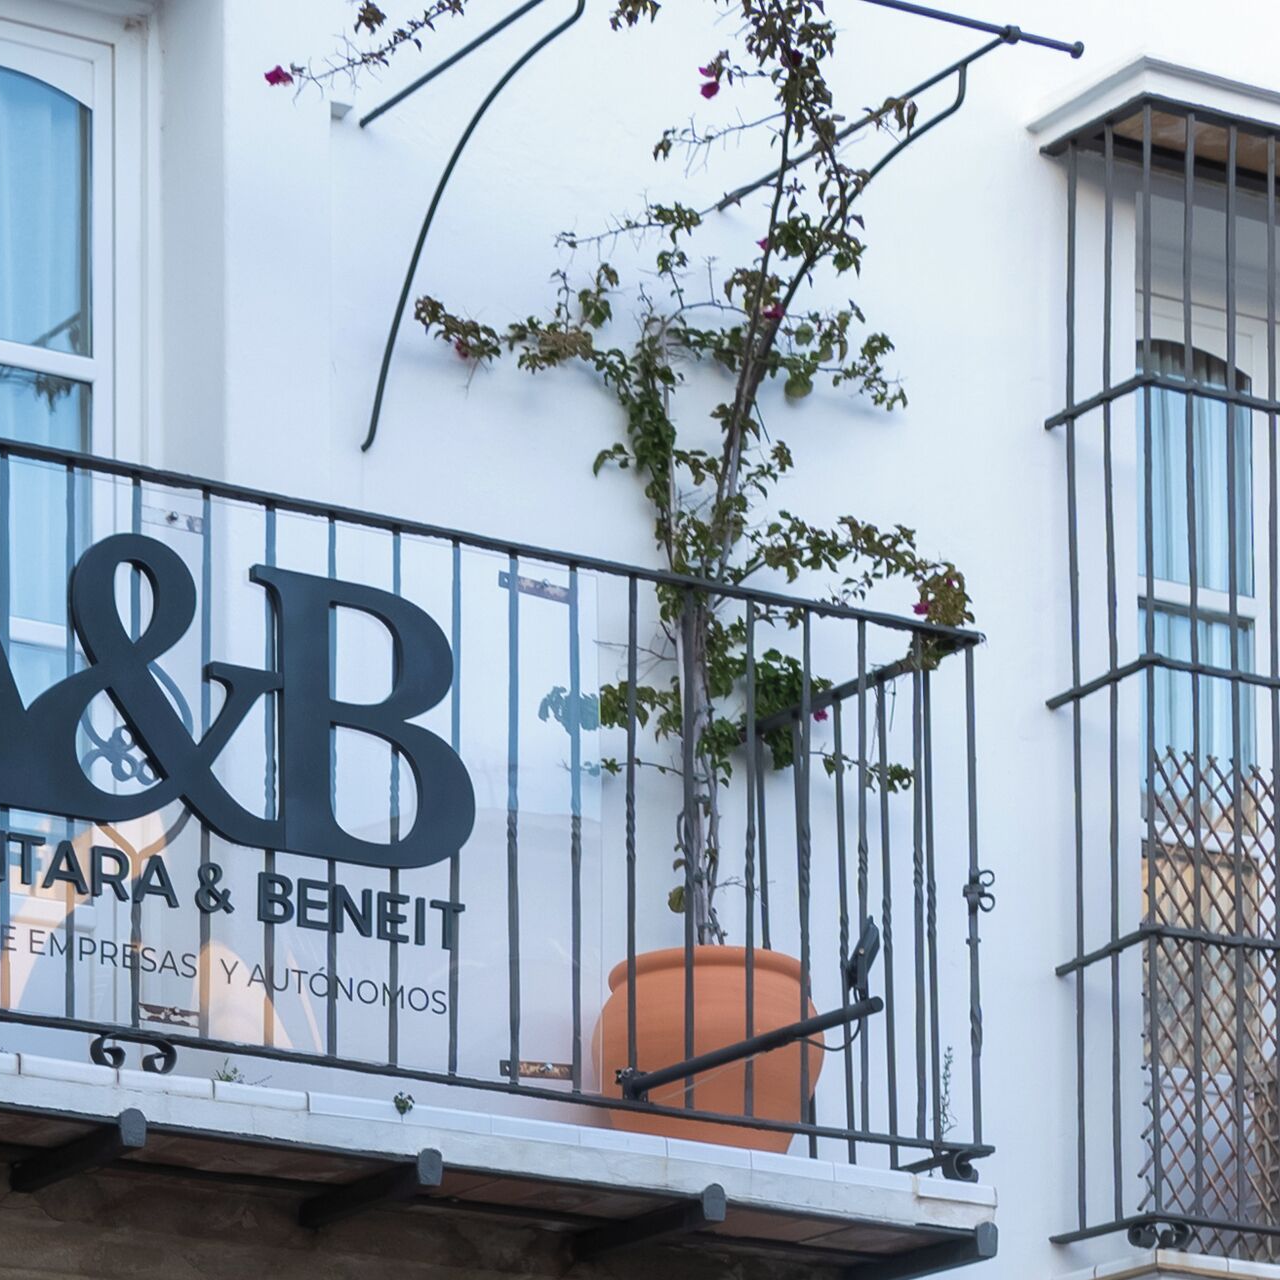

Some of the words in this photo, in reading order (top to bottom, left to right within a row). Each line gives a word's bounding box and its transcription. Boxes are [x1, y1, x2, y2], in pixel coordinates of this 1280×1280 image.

[194, 862, 236, 915] &
[257, 871, 466, 951] BENEIT
[28, 928, 198, 979] EMPRESAS
[219, 958, 239, 985] Y
[247, 963, 449, 1015] AUTÓNOMOS
